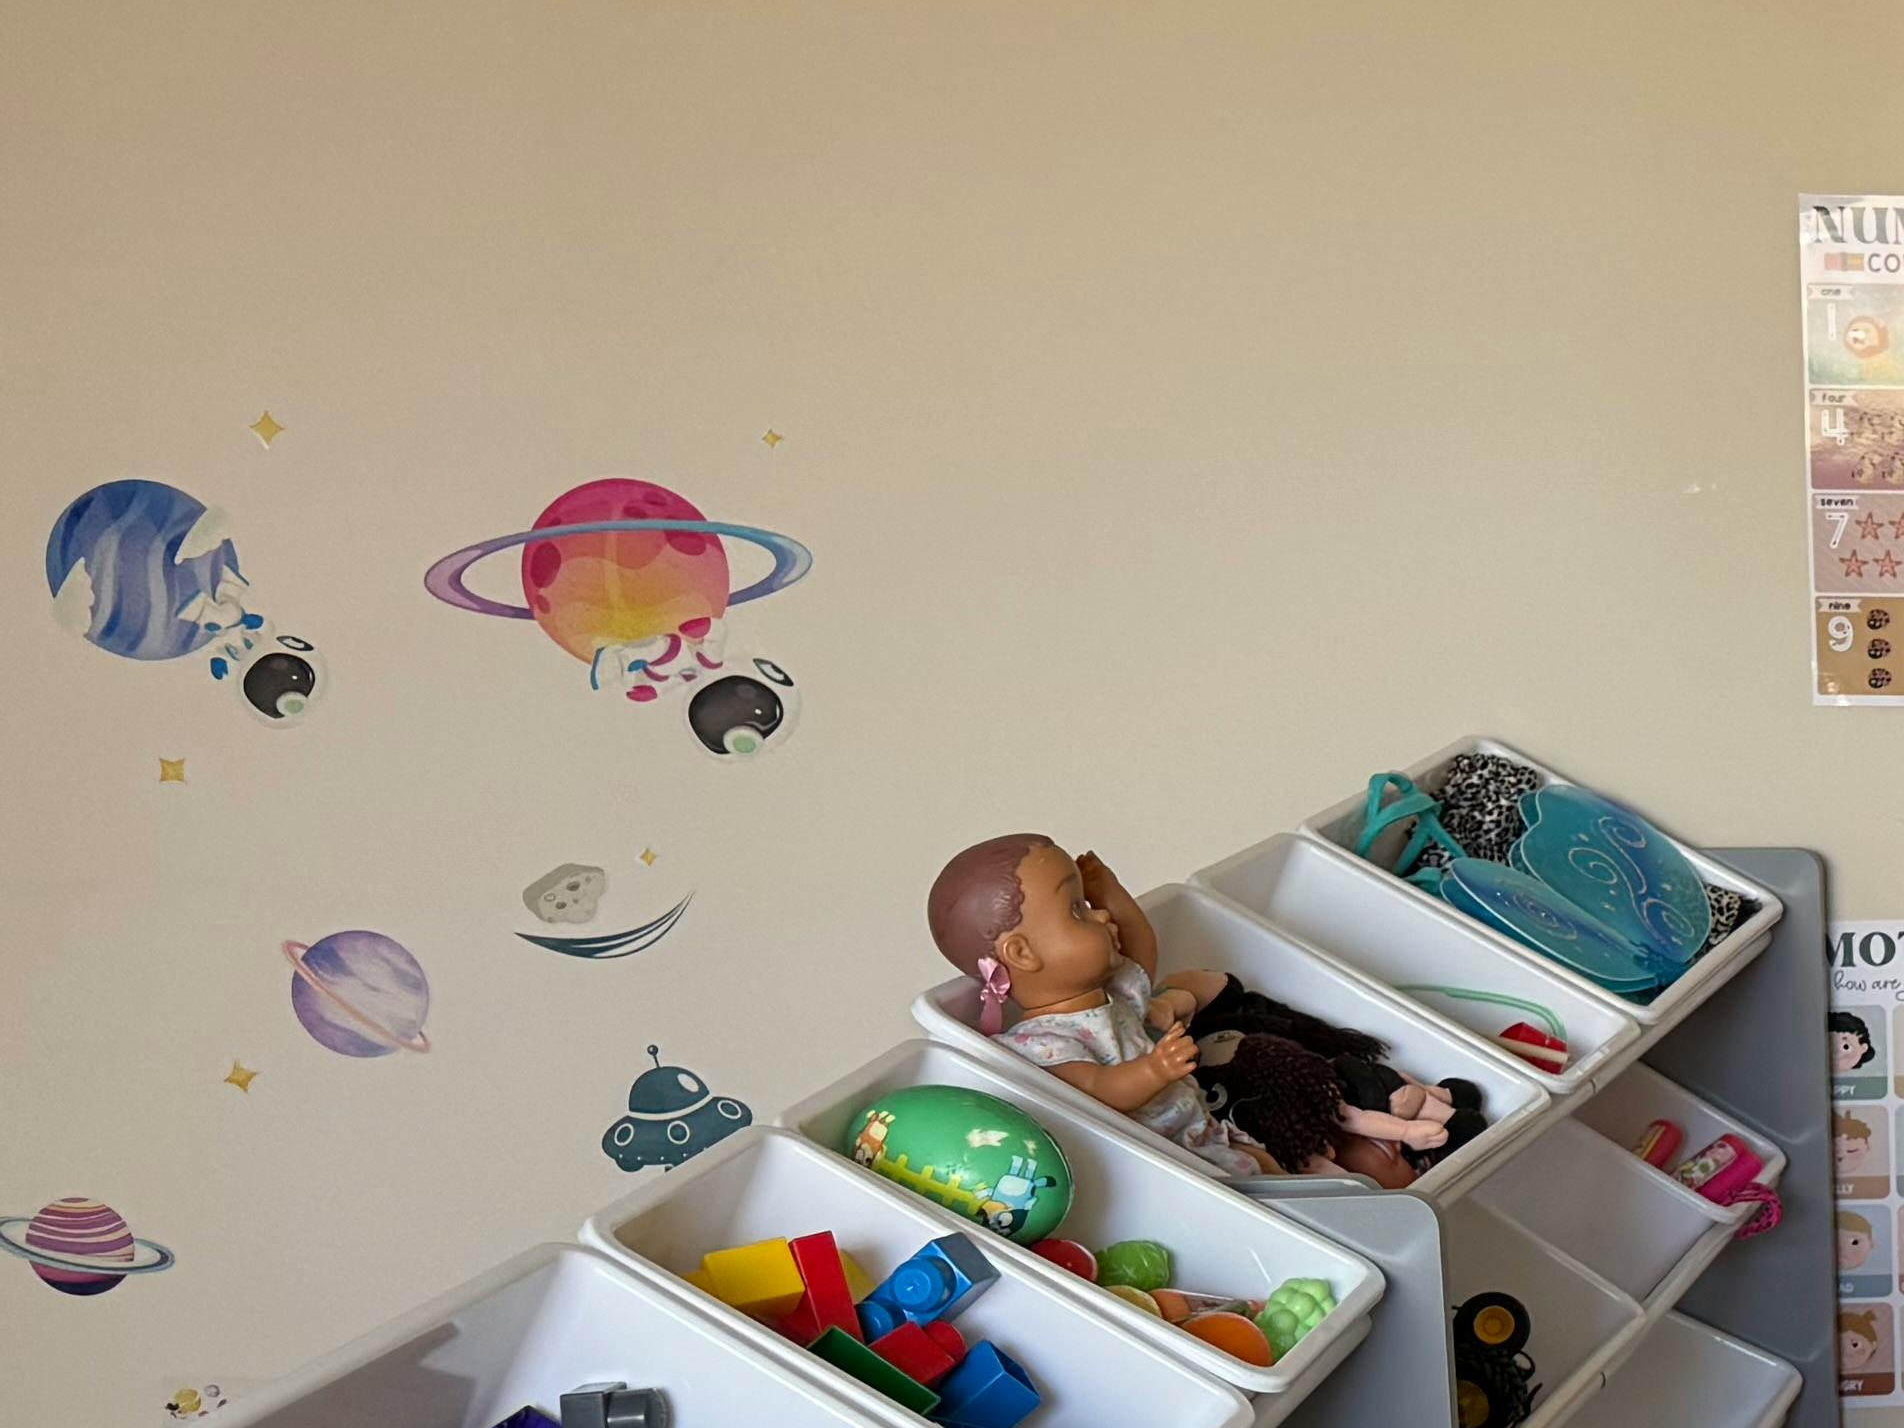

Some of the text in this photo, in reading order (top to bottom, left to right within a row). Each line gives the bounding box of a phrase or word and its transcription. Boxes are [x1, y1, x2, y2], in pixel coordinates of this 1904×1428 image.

[1820, 498, 1853, 506] seven
[1825, 513, 1848, 548] 7
[1828, 616, 1853, 652] 9
[1833, 971, 1867, 991] how
[1872, 981, 1900, 990] are
